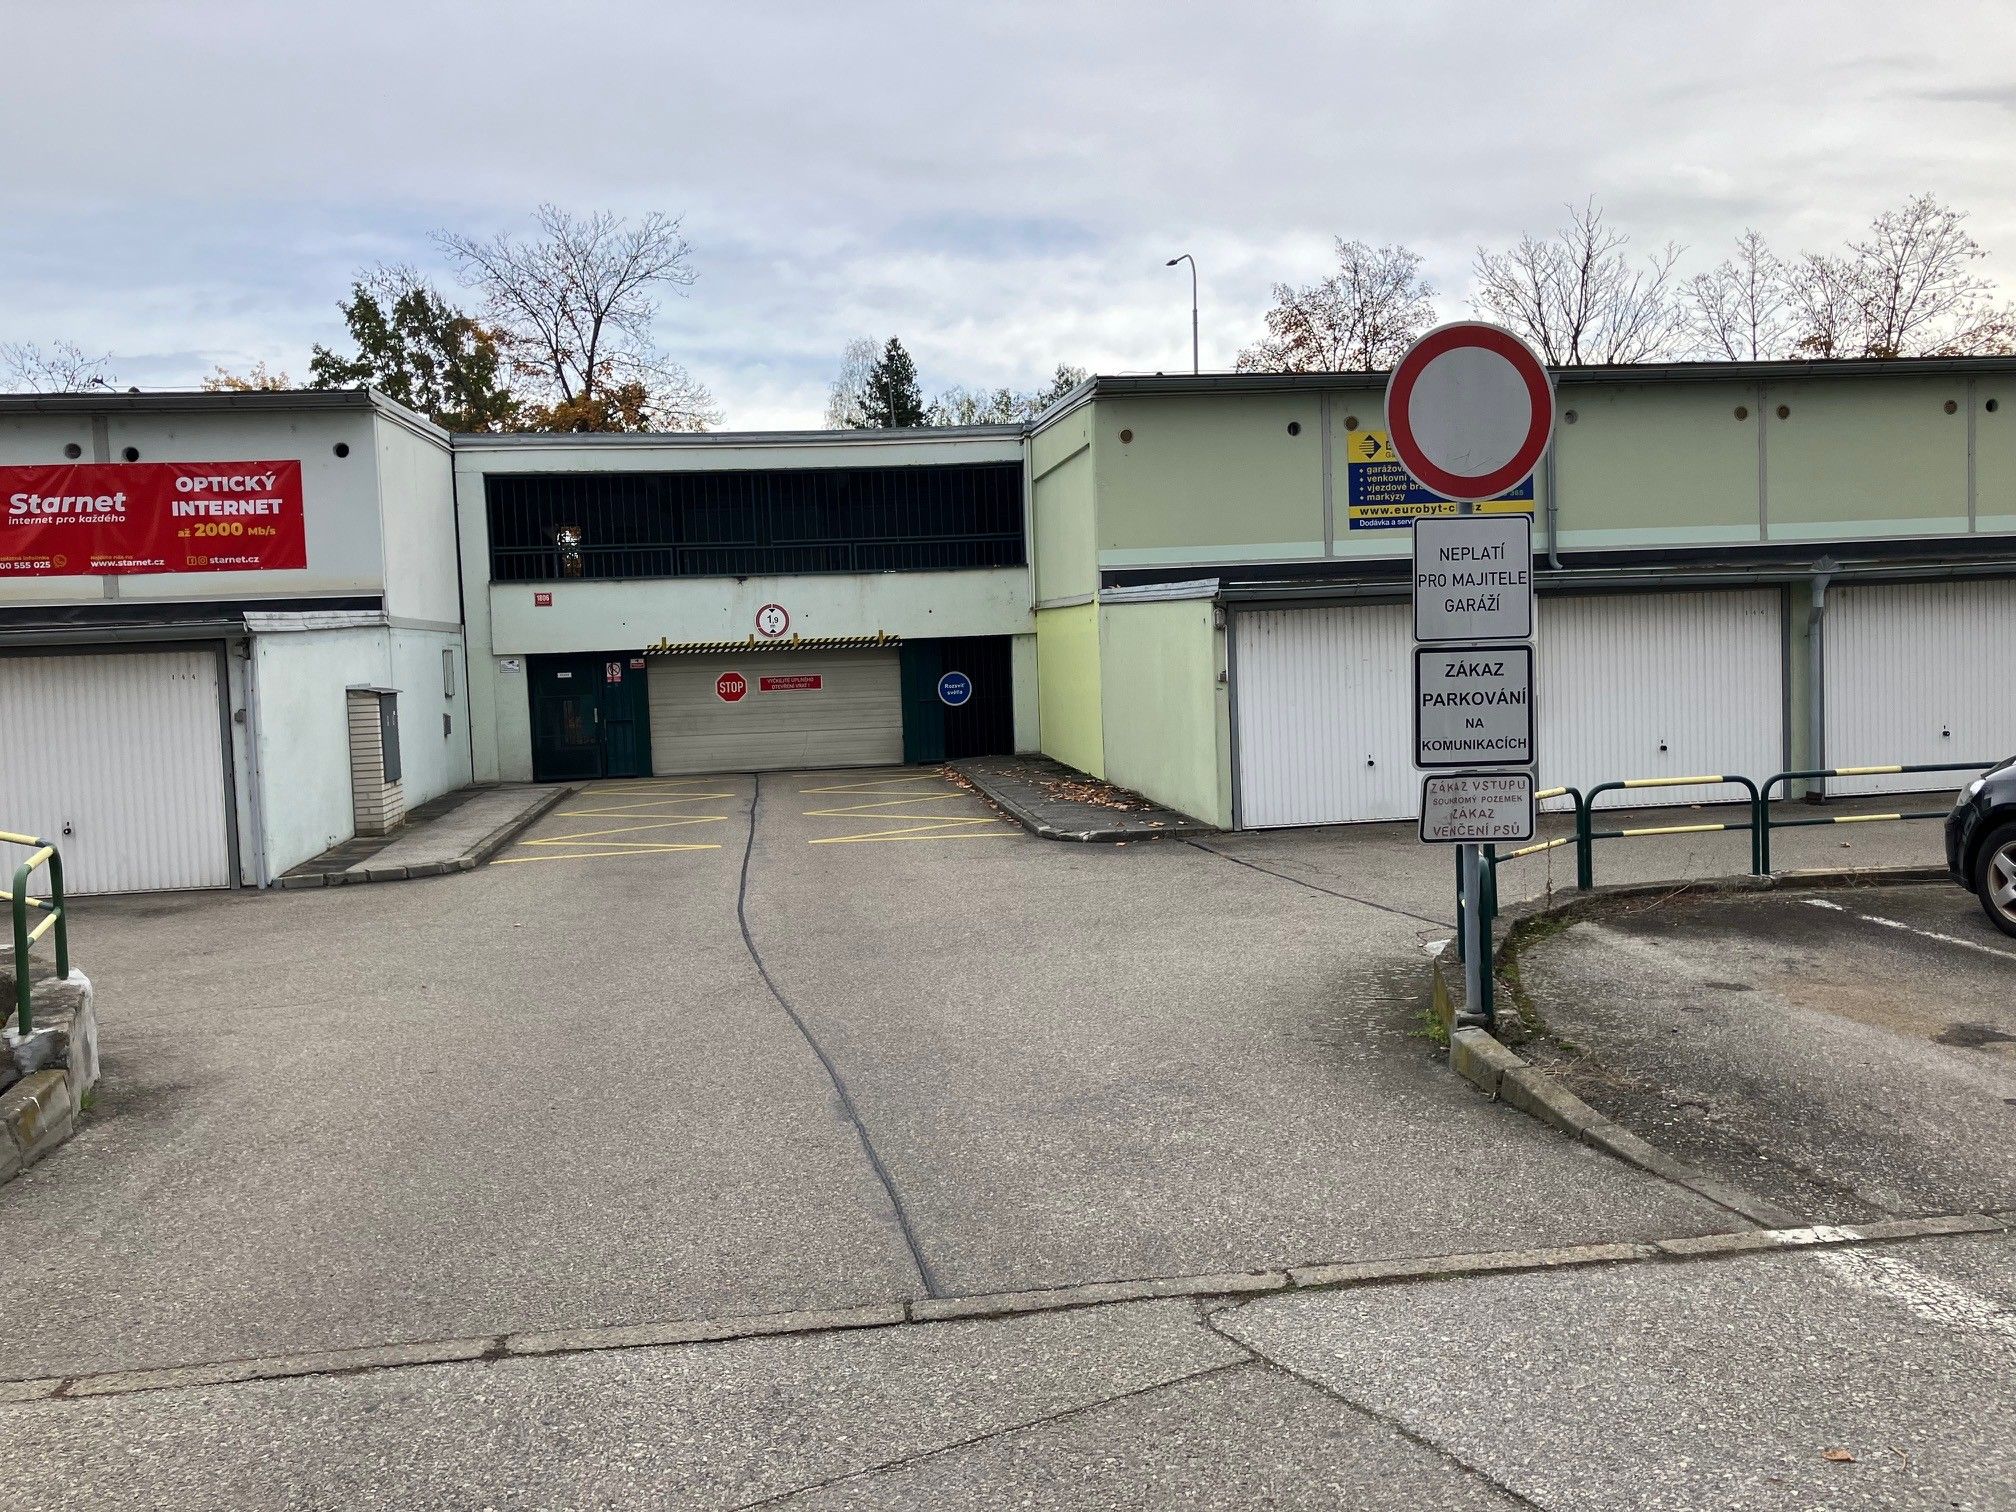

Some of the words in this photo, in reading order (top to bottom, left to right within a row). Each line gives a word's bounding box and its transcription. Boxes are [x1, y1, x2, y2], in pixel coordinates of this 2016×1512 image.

[1366, 464, 1405, 475] garážov
[175, 471, 277, 493] OPTICKÝ
[1367, 483, 1407, 493] vjezdové
[1366, 492, 1406, 501] markýzy
[8, 492, 127, 515] Starnet
[171, 499, 283, 517] INTERNET
[8, 515, 53, 525] internet
[56, 516, 76, 525] pro
[79, 514, 126, 524] každého
[1359, 519, 1390, 527] Dodávka
[177, 528, 192, 538] až
[194, 522, 243, 537] 2000
[247, 525, 276, 536] Mb/s
[1439, 541, 1506, 561] NEPLATÍ
[14, 561, 32, 569] 555
[33, 561, 51, 569] 025
[90, 558, 165, 568] www.starnet.cz
[209, 555, 260, 565] starnet.cz
[1418, 573, 1447, 588] PRO
[1452, 570, 1528, 586] MAJITELE
[1444, 593, 1501, 613] GARÁŽÍ
[1444, 660, 1504, 678] ZÁKAZ
[719, 681, 744, 694] STOP
[1422, 687, 1527, 707] PARKOVÁNÍ
[1465, 717, 1485, 729] NA
[1421, 736, 1527, 751] KOMUNIKACÍCH
[1472, 780, 1527, 791] VSTUPU
[1481, 795, 1523, 803] POZEMEK
[1452, 806, 1496, 820] ZÁKAZ
[1433, 823, 1490, 837] VENČENÍ
[1493, 821, 1521, 836] PSŮ
